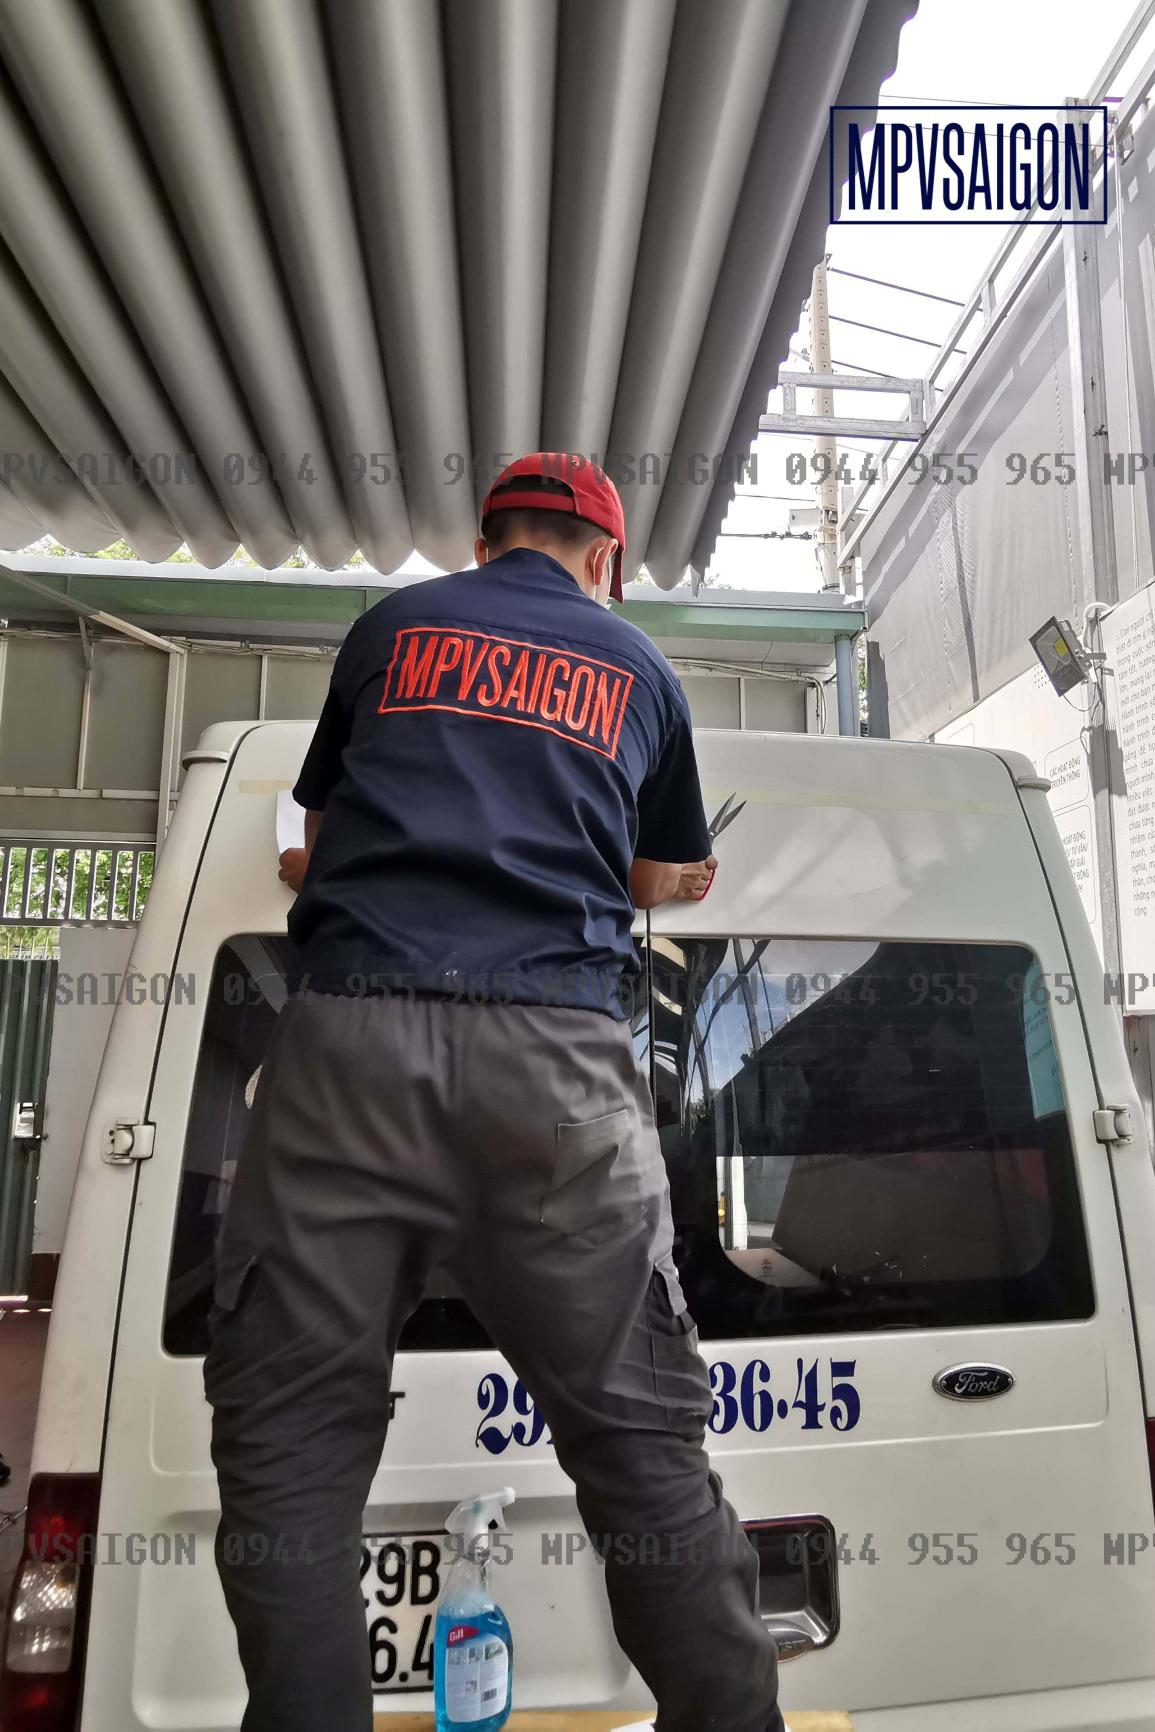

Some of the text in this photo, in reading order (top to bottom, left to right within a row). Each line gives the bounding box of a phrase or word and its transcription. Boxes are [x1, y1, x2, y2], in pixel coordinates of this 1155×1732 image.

[395, 636, 621, 745] MPVSAIGON
[476, 1373, 555, 1455] 29
[955, 1371, 999, 1393] Ford
